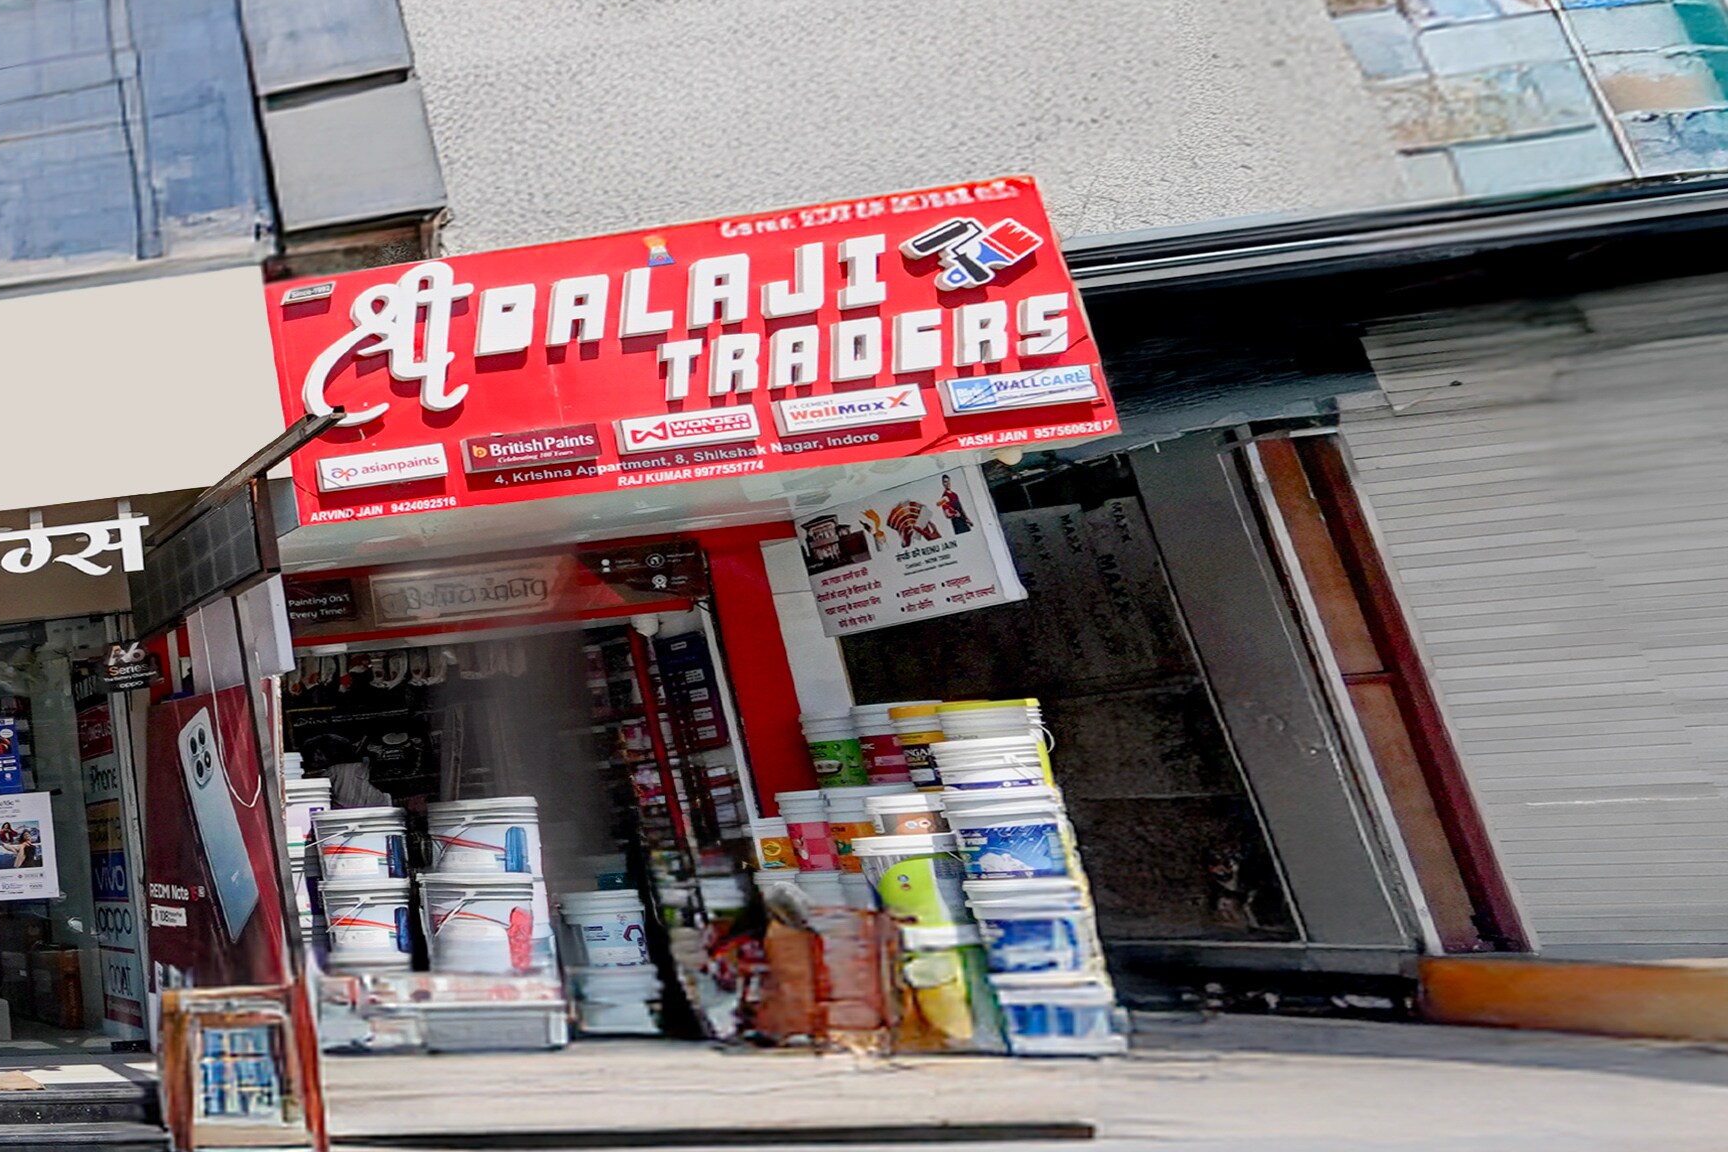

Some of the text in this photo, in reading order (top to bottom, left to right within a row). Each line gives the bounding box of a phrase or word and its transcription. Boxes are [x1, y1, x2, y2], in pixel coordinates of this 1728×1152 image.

[302, 261, 474, 428] श्री
[657, 292, 1070, 402] TRADERS
[670, 414, 749, 431] WONDER
[673, 427, 711, 436] WALL
[490, 433, 595, 458] British Paints
[957, 433, 994, 448] YASH
[996, 430, 1028, 443] JAIN
[361, 454, 441, 475] asianpaints
[495, 473, 510, 486] 4,
[512, 466, 573, 484] Krishna
[675, 453, 690, 465] 8,
[693, 444, 767, 463] Shikshak
[769, 437, 824, 453] Nagar,
[826, 432, 880, 447] Indore
[618, 460, 765, 487] RAJ KUMAR 9977551774
[310, 496, 457, 523] ARVIND JAIN 9424092516
[289, 611, 318, 620] Every
[108, 664, 149, 676] Series
[119, 680, 144, 688] oppo
[95, 860, 125, 892] vivo
[149, 883, 171, 900] REDMI
[171, 884, 190, 901] Note
